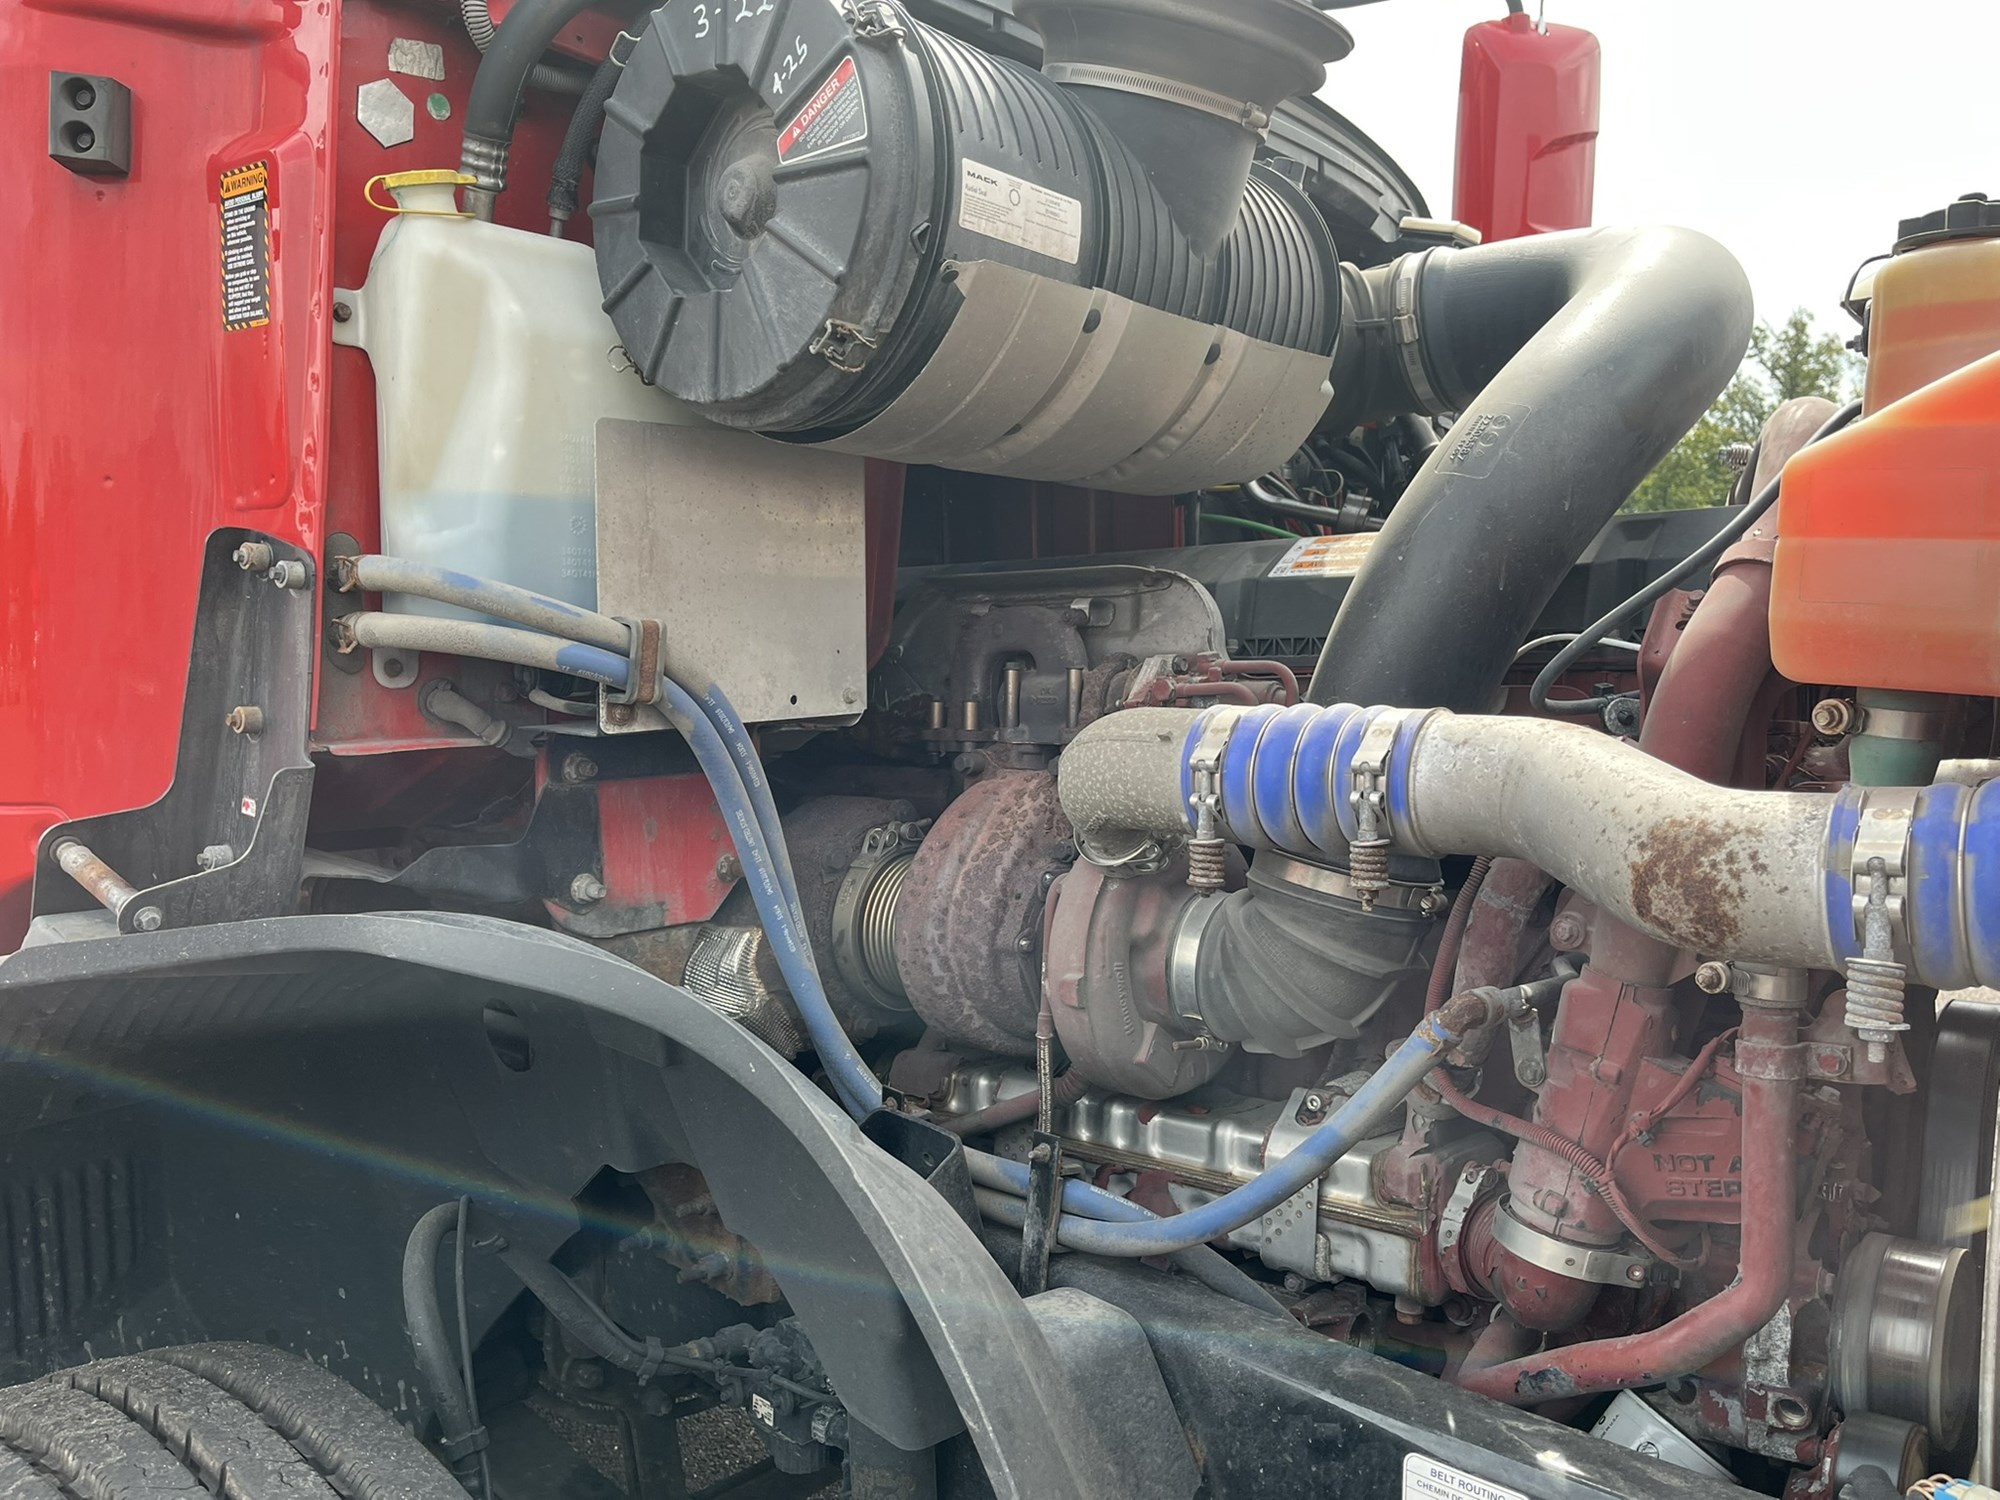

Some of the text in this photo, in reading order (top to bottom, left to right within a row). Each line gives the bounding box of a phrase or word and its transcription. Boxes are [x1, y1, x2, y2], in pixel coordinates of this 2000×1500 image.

[800, 77, 839, 126] DANGER
[806, 81, 856, 141] CAUSE ENGINE DAMAGE OR
[798, 133, 805, 142] DO
[804, 124, 813, 135] NOT
[820, 100, 833, 116] ETHER
[821, 119, 838, 140] SERIOUS
[837, 97, 857, 121] PERSONAL
[825, 127, 839, 144] INJURY
[839, 119, 845, 129] OR
[231, 172, 263, 191] WARNING
[967, 170, 998, 187] MACK
[1653, 1154, 1742, 1173] NOT A
[1665, 1178, 1742, 1198] STEP
[1430, 1468, 1456, 1484] BELT
[1416, 1480, 1450, 1498] CHEMIN
